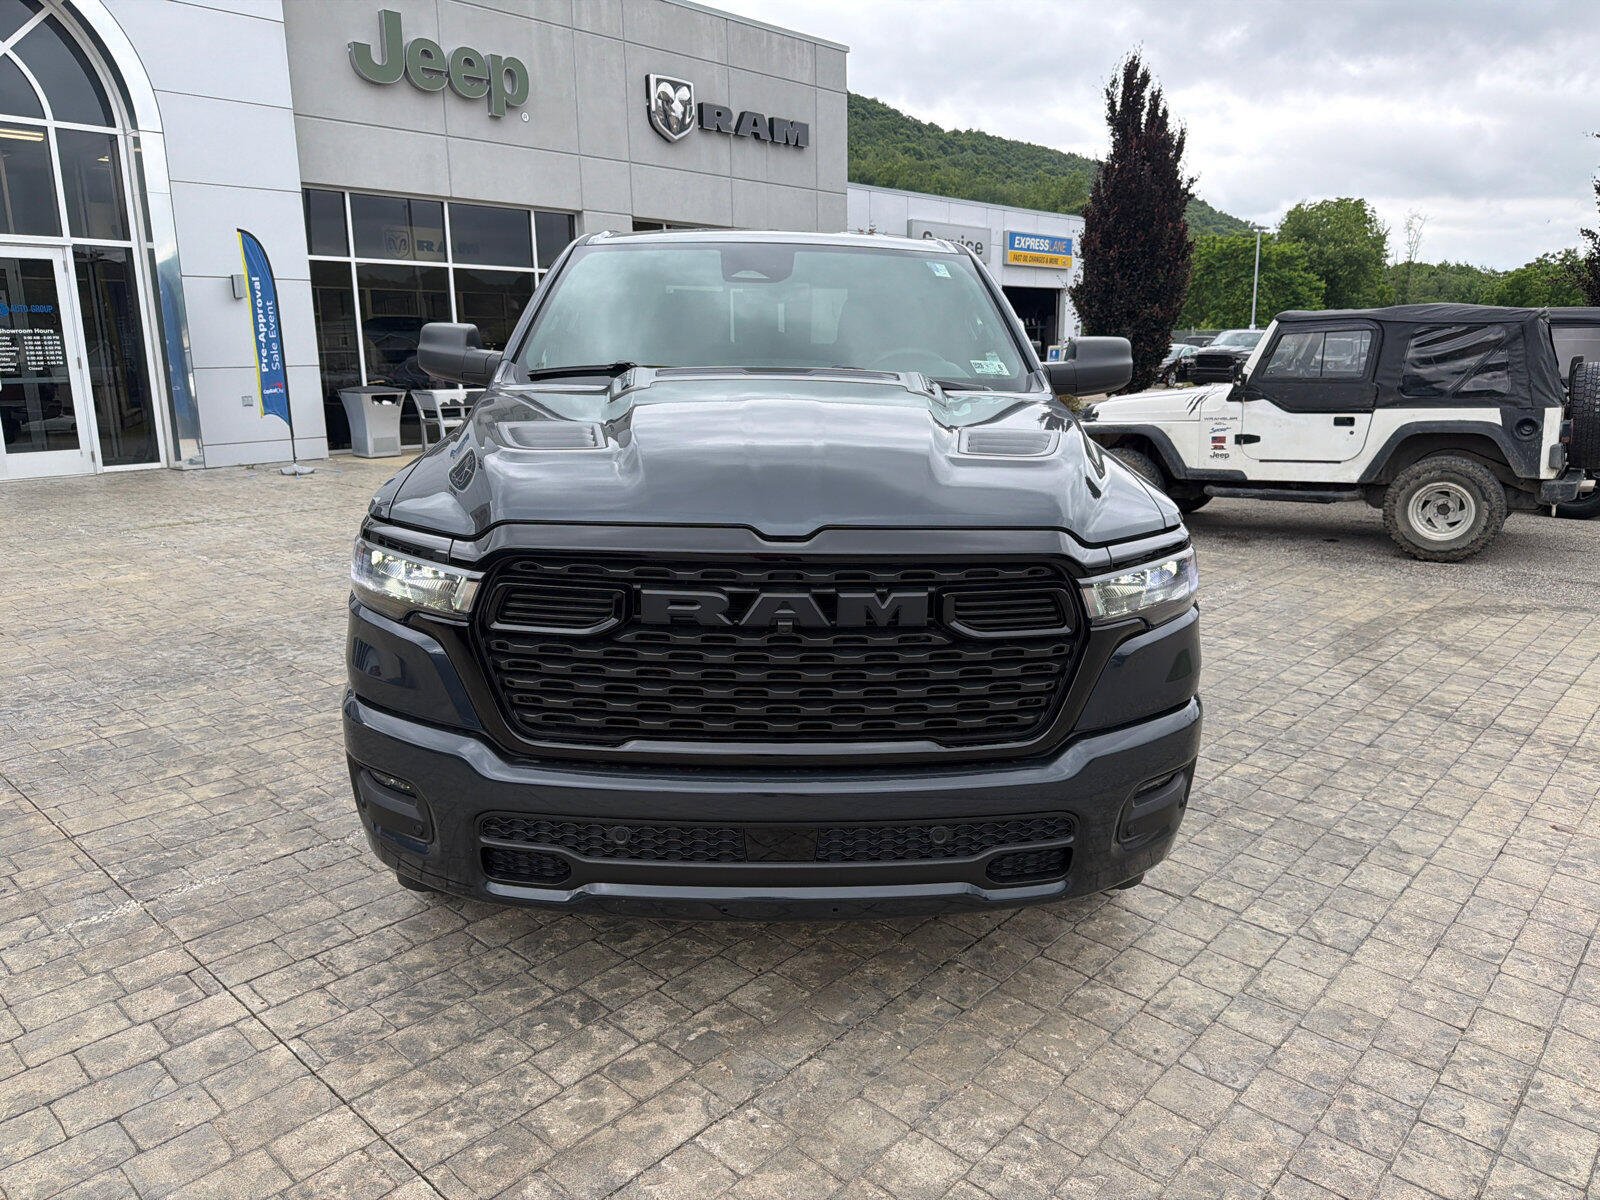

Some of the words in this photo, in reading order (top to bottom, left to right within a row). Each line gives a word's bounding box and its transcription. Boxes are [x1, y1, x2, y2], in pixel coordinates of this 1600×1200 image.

[348, 9, 530, 119] Jeep
[697, 102, 809, 148] RAM
[1014, 236, 1050, 251] EXPRESS
[1050, 240, 1067, 253] LANE
[31, 304, 54, 314] GROUP
[252, 277, 269, 373] Pre-Approval
[266, 300, 277, 338] Event
[270, 342, 281, 371] Sale
[1210, 451, 1230, 459] Jeep
[641, 589, 928, 626] RAM
